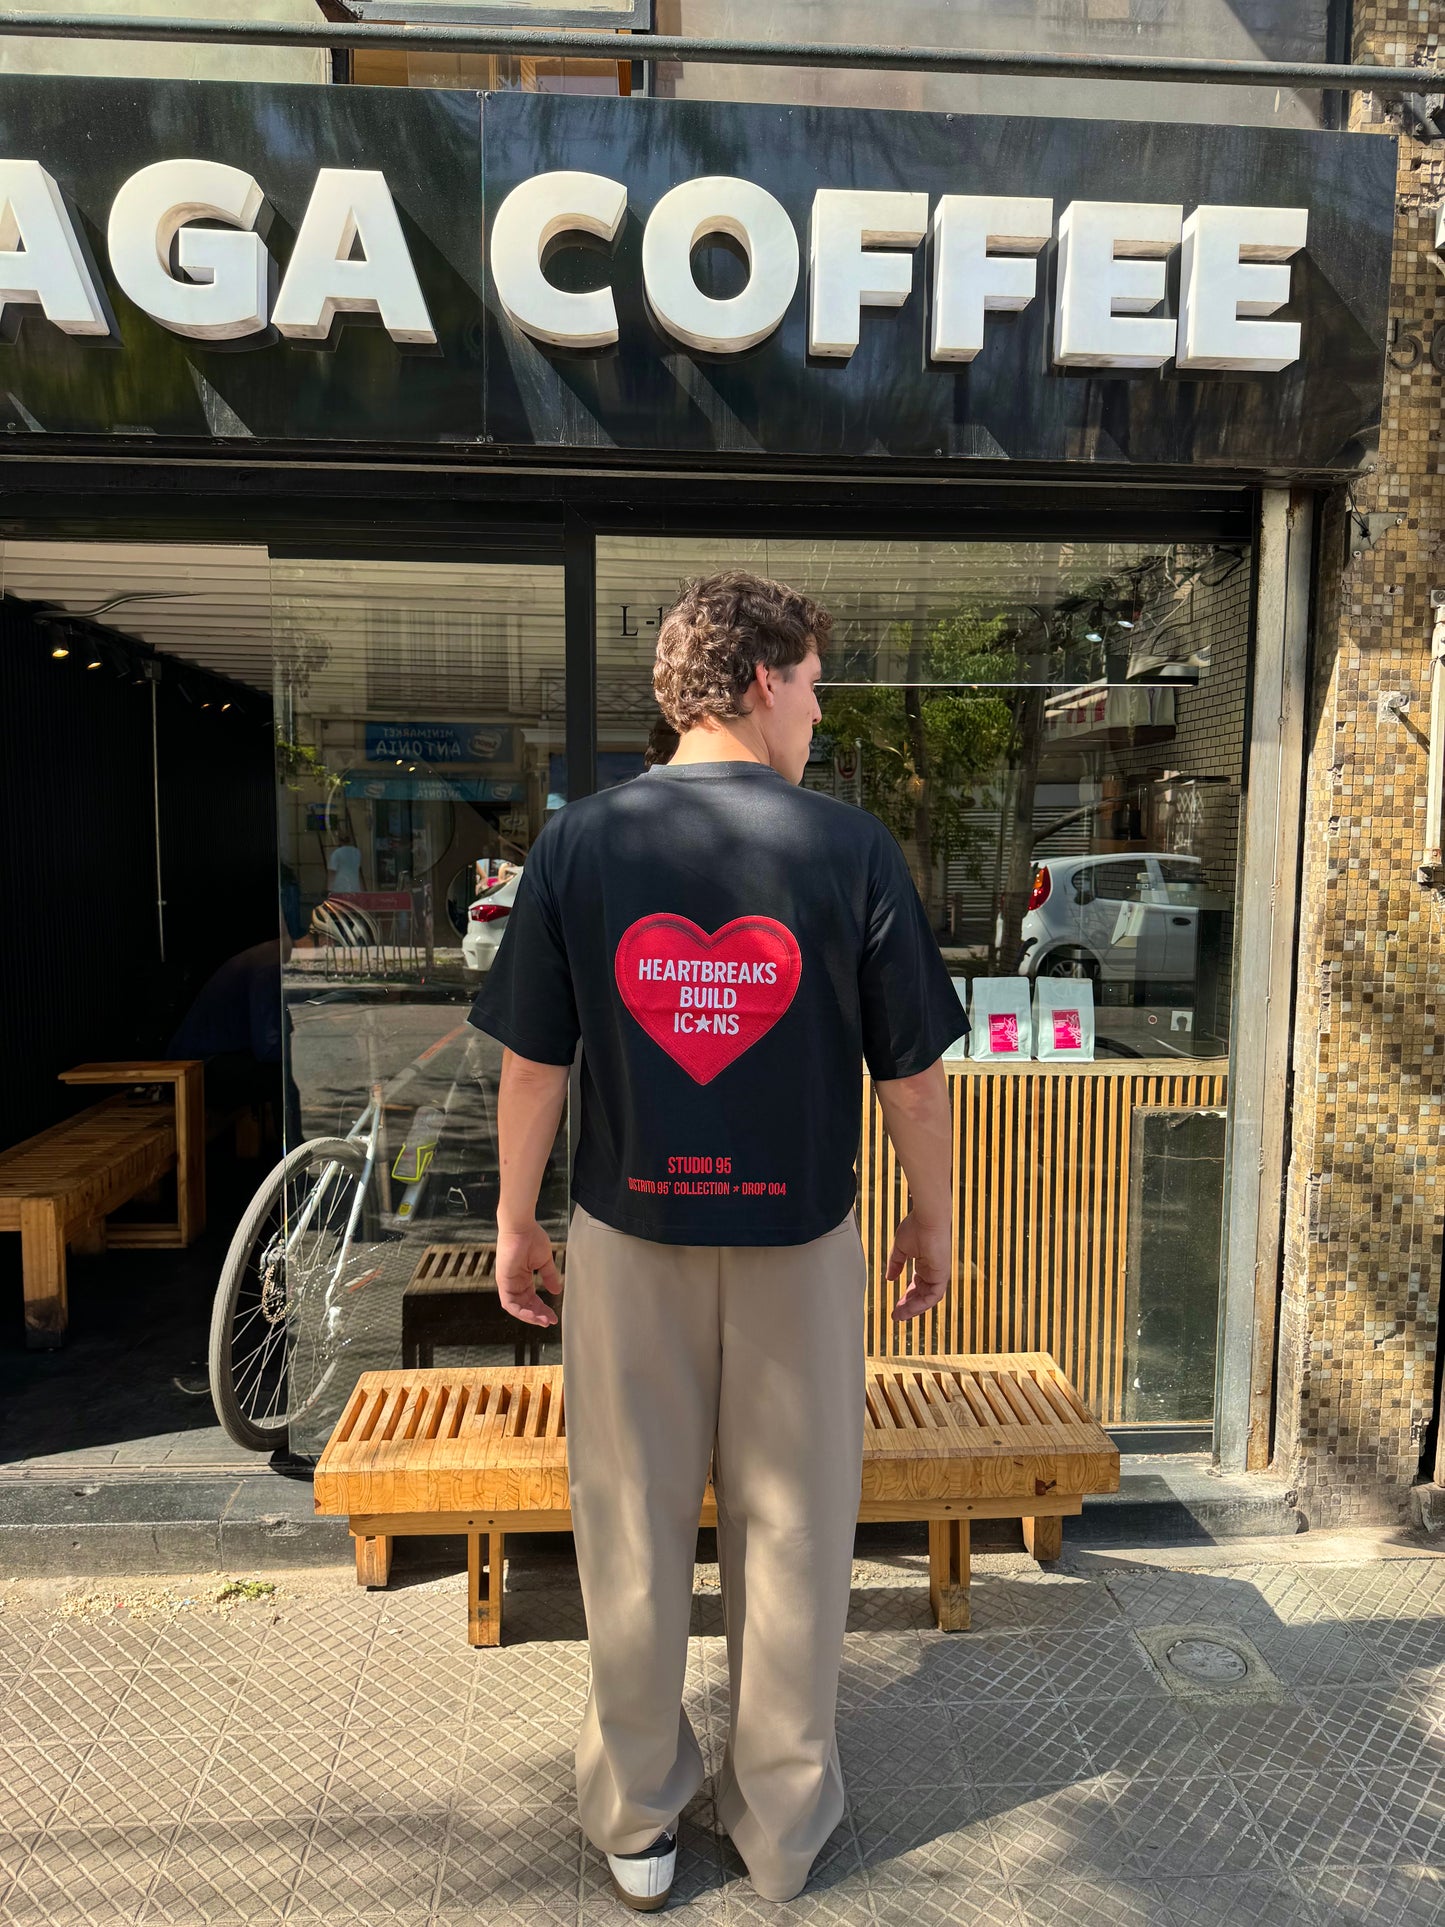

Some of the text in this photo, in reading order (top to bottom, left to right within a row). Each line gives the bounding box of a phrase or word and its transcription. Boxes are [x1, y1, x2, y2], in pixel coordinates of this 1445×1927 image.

[490, 170, 1309, 371] COFFEE
[638, 958, 777, 985] HEARTBREAKS
[679, 986, 737, 1009] BUILD
[667, 1156, 732, 1174] STUDIO 95
[673, 1181, 730, 1195] COLLECTION
[741, 1182, 766, 1195] DROP
[768, 1182, 787, 1196] 004
